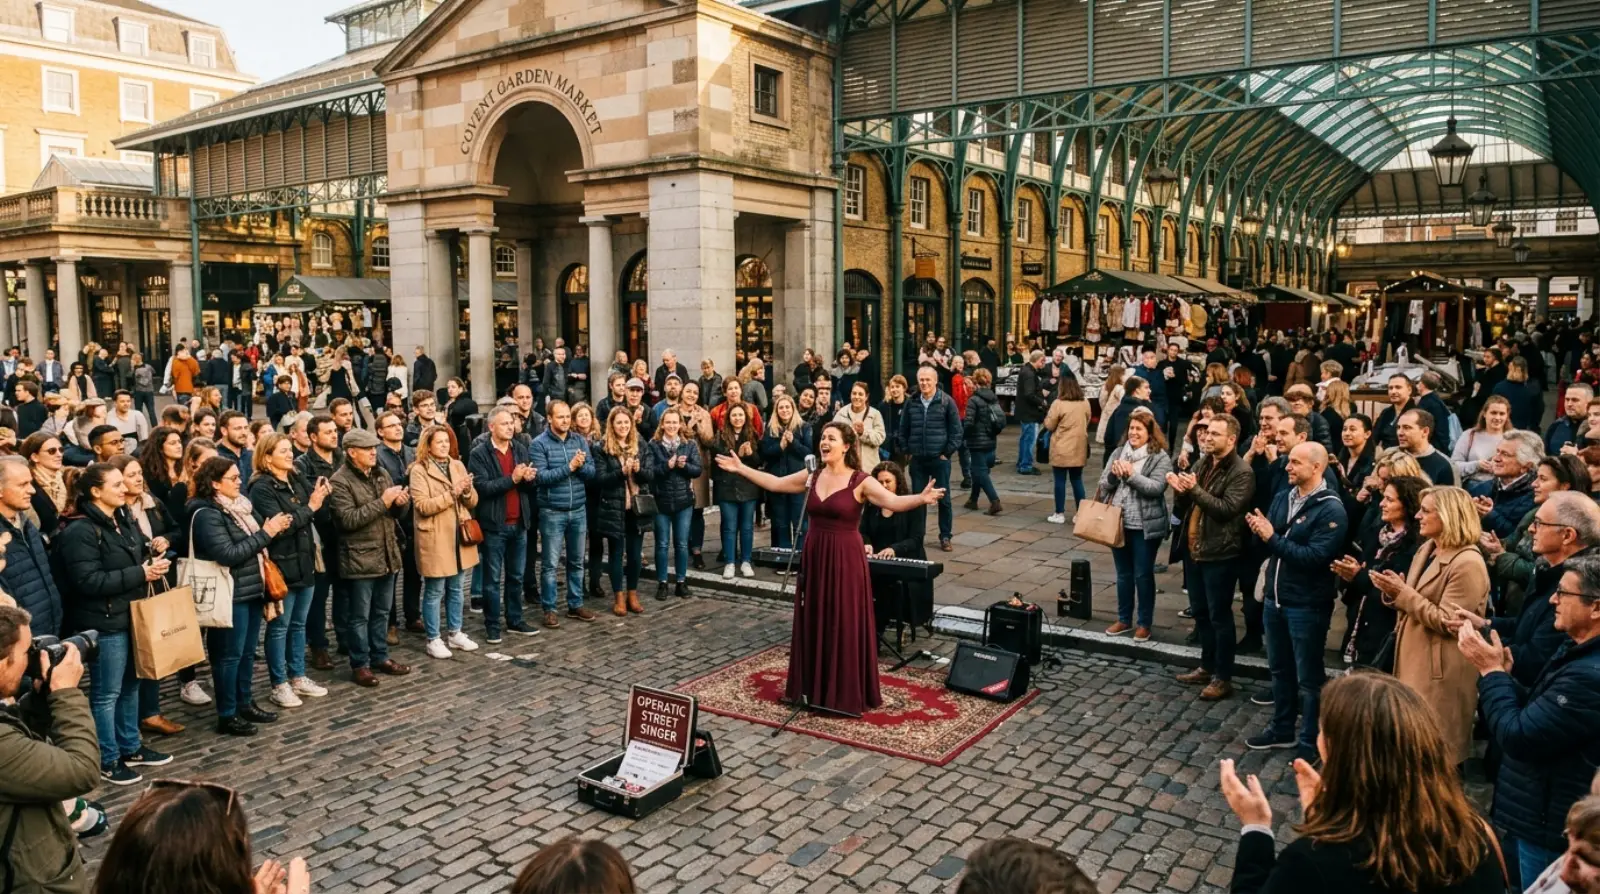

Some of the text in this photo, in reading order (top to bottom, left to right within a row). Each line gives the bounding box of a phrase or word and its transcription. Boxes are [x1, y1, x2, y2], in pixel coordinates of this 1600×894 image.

[460, 68, 603, 155] COVENT GARDEN MARKET
[637, 695, 686, 718] OPERATIC
[641, 710, 679, 729] STREET
[640, 723, 677, 743] SINGER
